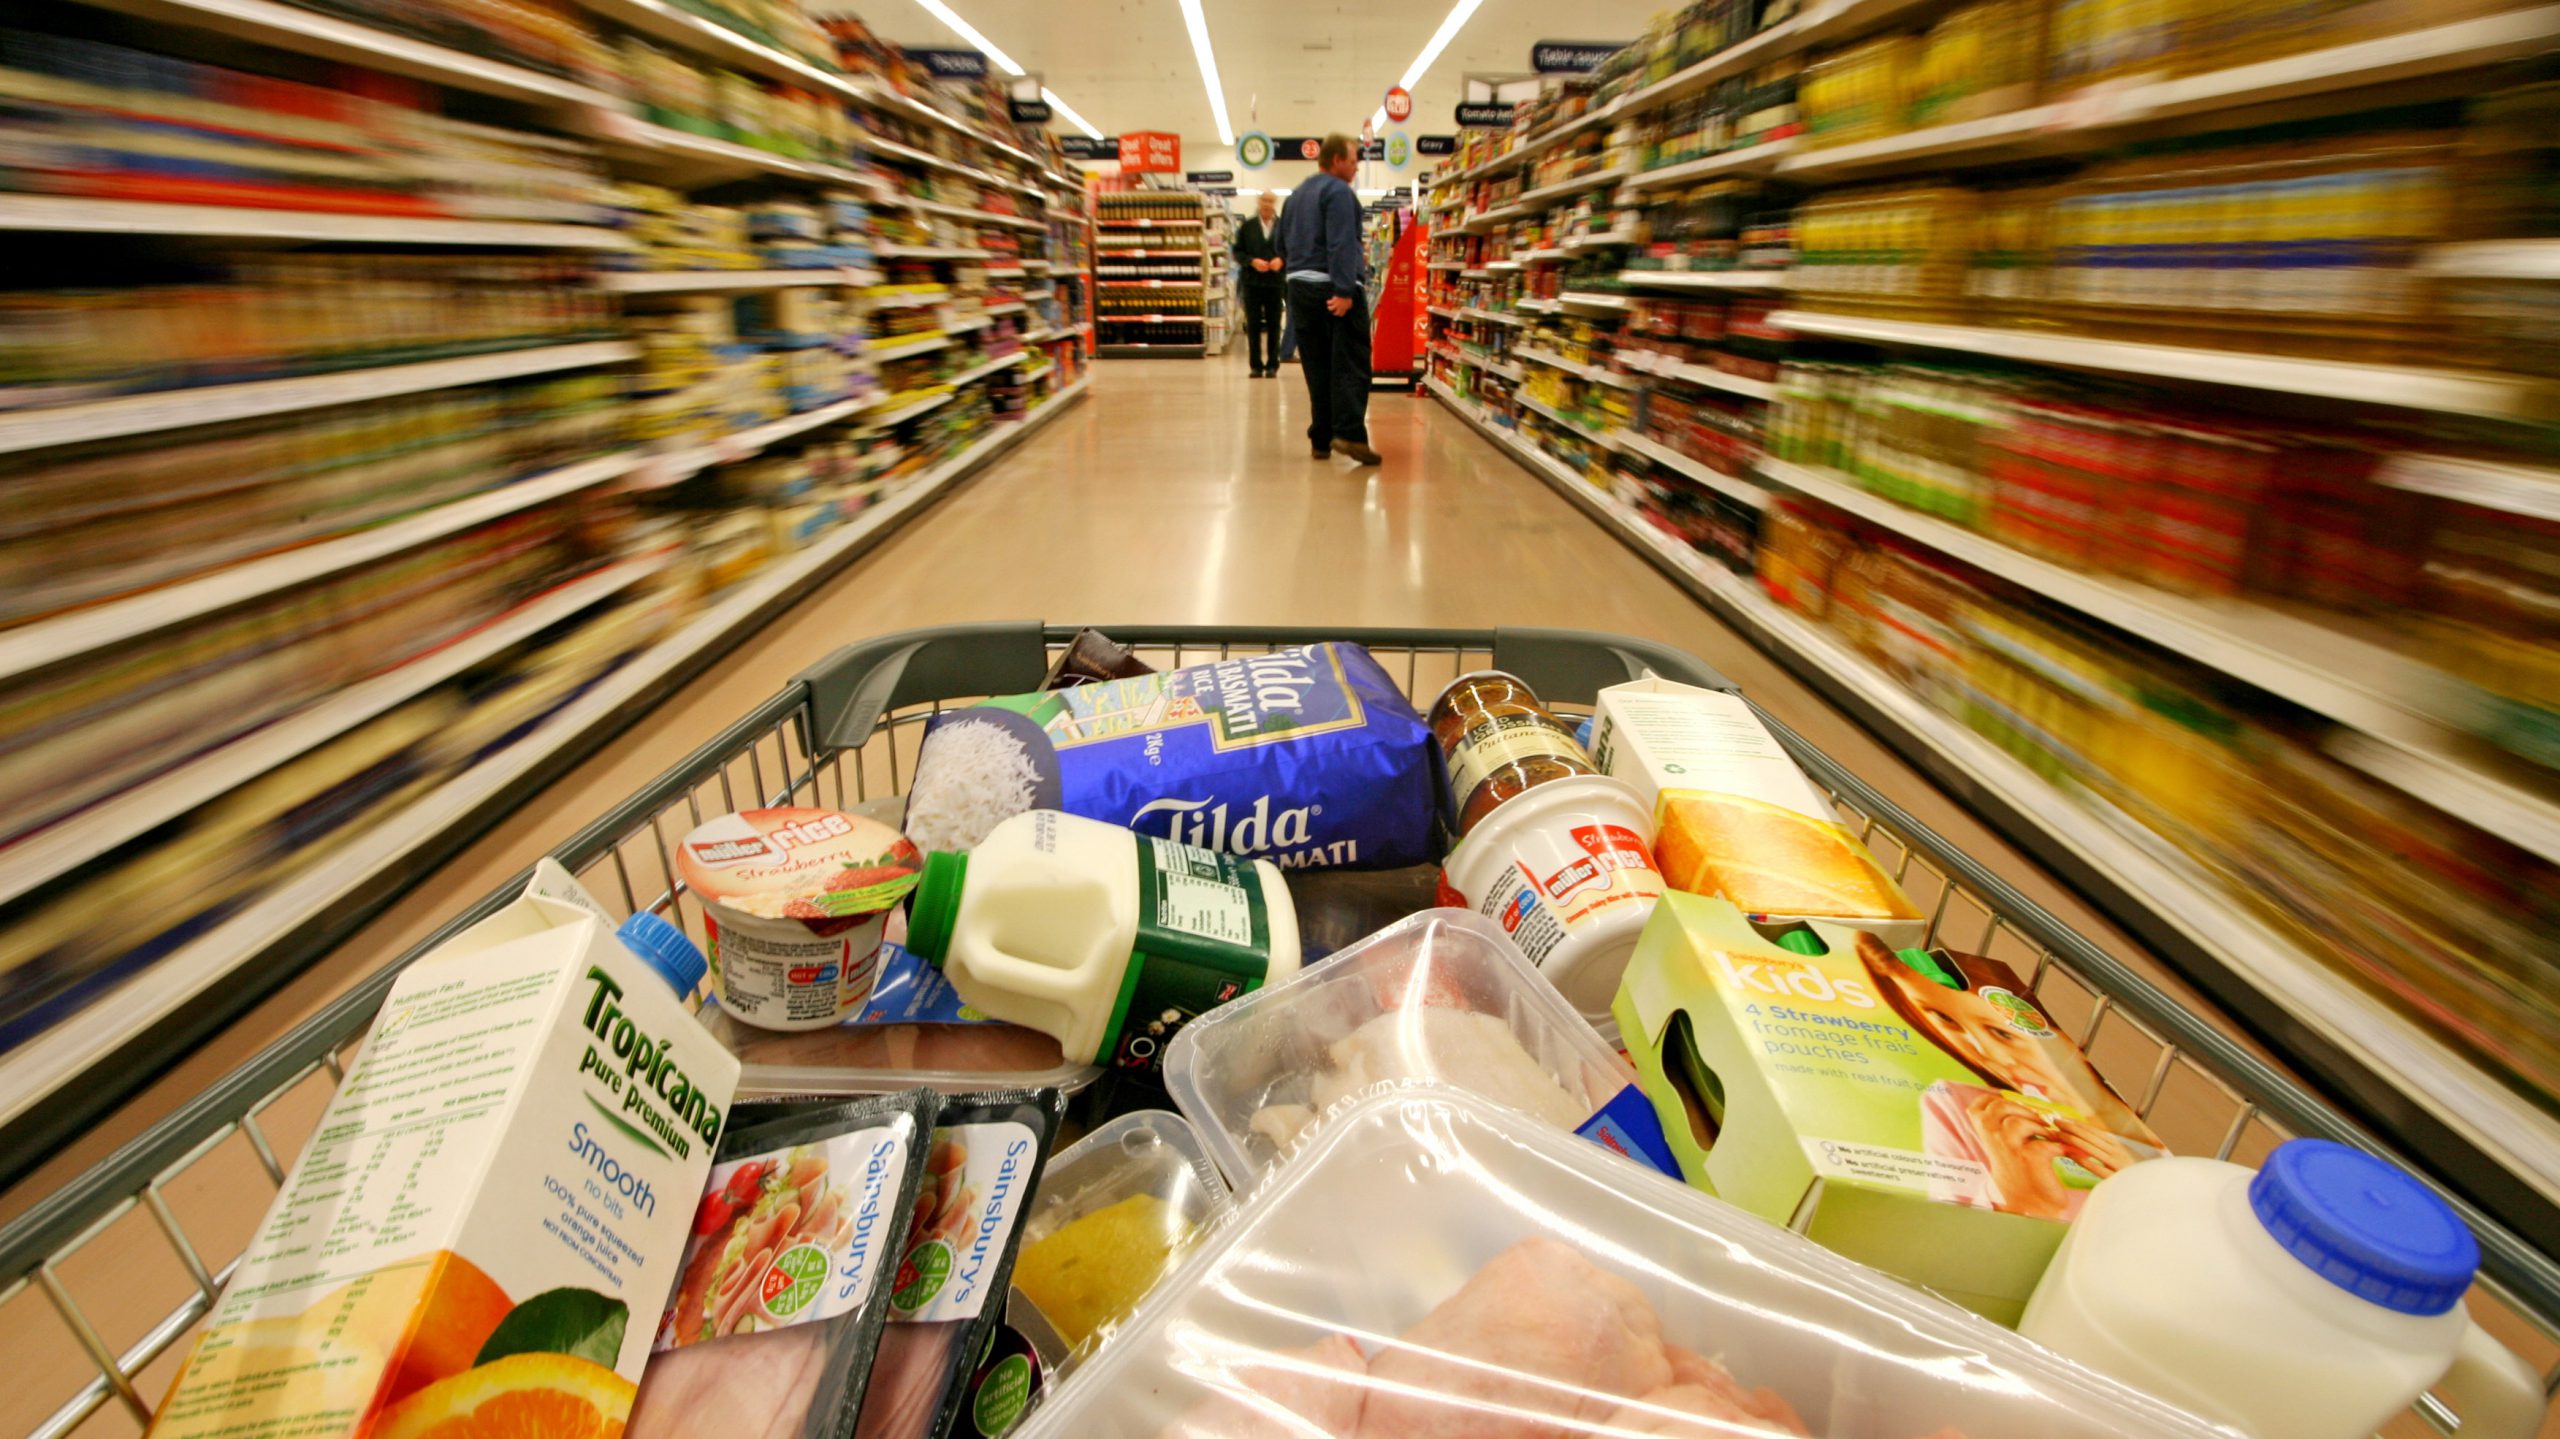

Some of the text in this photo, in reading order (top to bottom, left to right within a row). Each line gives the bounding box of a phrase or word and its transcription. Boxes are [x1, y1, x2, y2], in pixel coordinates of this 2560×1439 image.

[1192, 669, 1215, 696] RICE
[1217, 666, 1258, 735] BASMATI
[771, 814, 854, 851] rice
[1131, 795, 1312, 856] Tilda
[735, 849, 853, 881] Strawberry
[1550, 862, 1595, 898] müller
[1597, 849, 1648, 872] rice
[1712, 950, 1877, 1010] kids
[1745, 1003, 1910, 1041] 4 Strawberry
[1752, 1019, 1920, 1056] fromage frais
[582, 964, 722, 1147] Tropicana
[1763, 1039, 1870, 1065] pouches
[1775, 1062, 1817, 1077] made
[1819, 1066, 1848, 1081] with
[578, 1044, 623, 1095] pure
[621, 1082, 691, 1162] premium
[568, 1121, 657, 1219] Smooth
[543, 1174, 646, 1268] 100% pure squeezed
[583, 1177, 625, 1221] no bits
[839, 1139, 896, 1300] Sainsbury's
[954, 1139, 1029, 1304] Sainsbury's
[560, 1211, 619, 1266] orange juice
